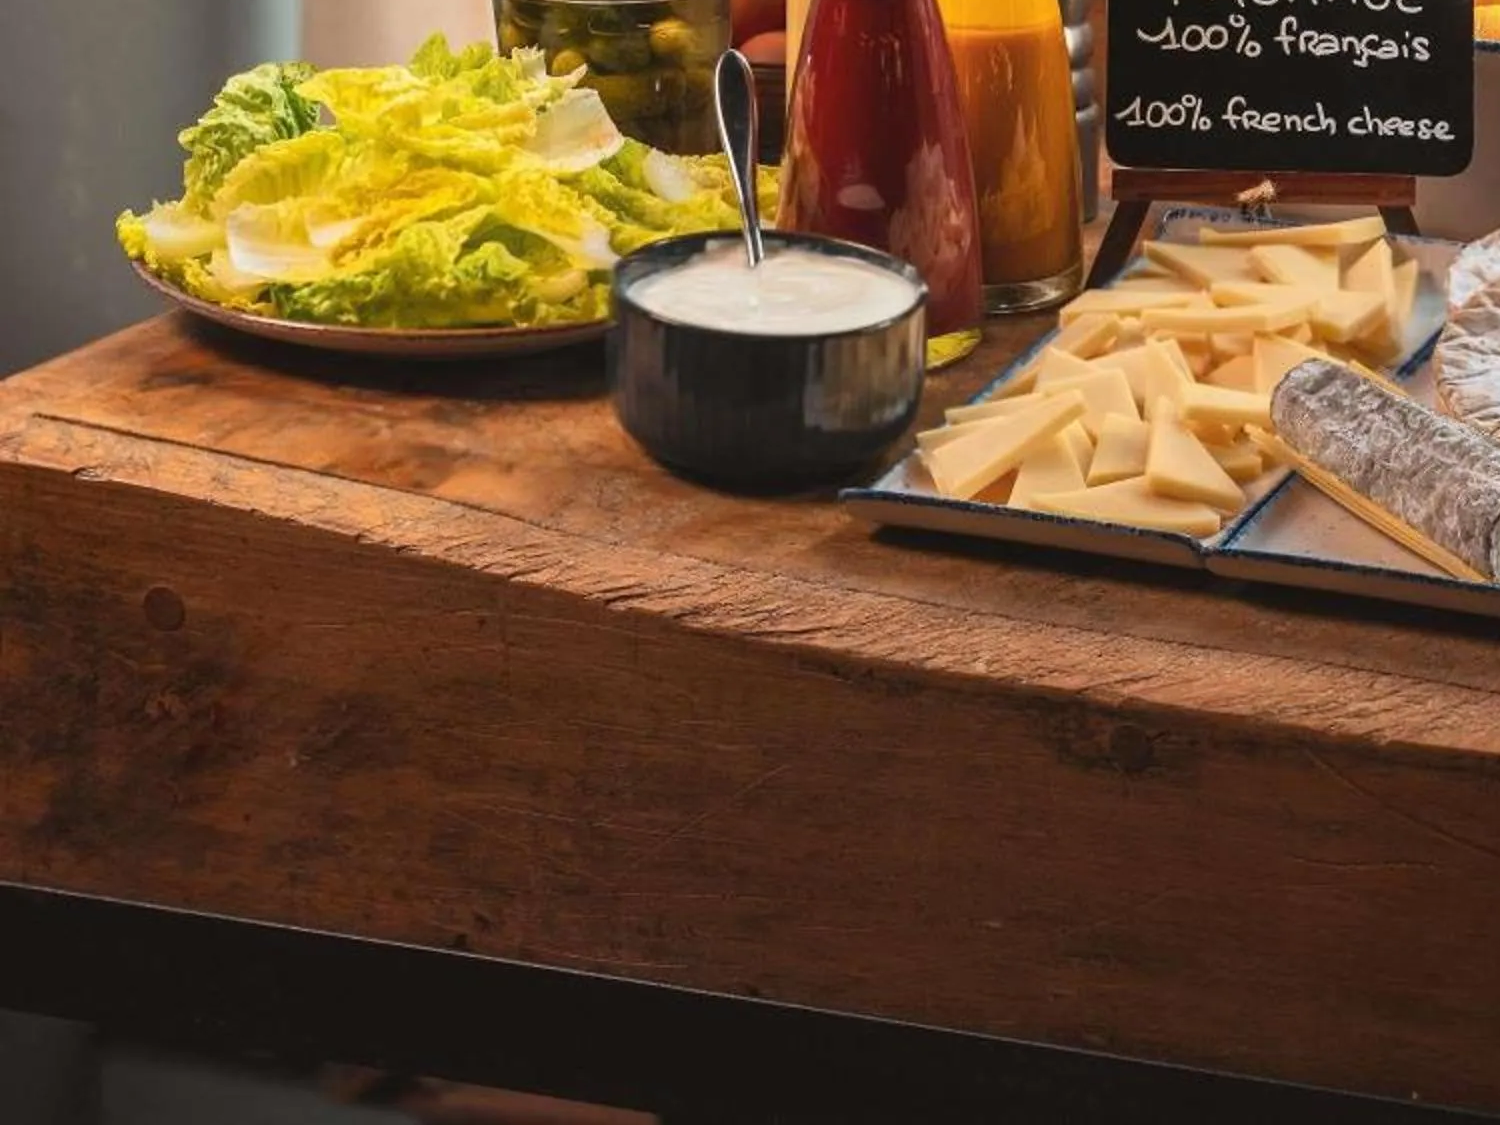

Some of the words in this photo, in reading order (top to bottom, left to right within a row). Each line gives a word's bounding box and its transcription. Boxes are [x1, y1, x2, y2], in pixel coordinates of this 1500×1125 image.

[1136, 13, 1262, 58] 100%
[1115, 94, 1212, 131] 100%
[1347, 105, 1455, 142] cheese
